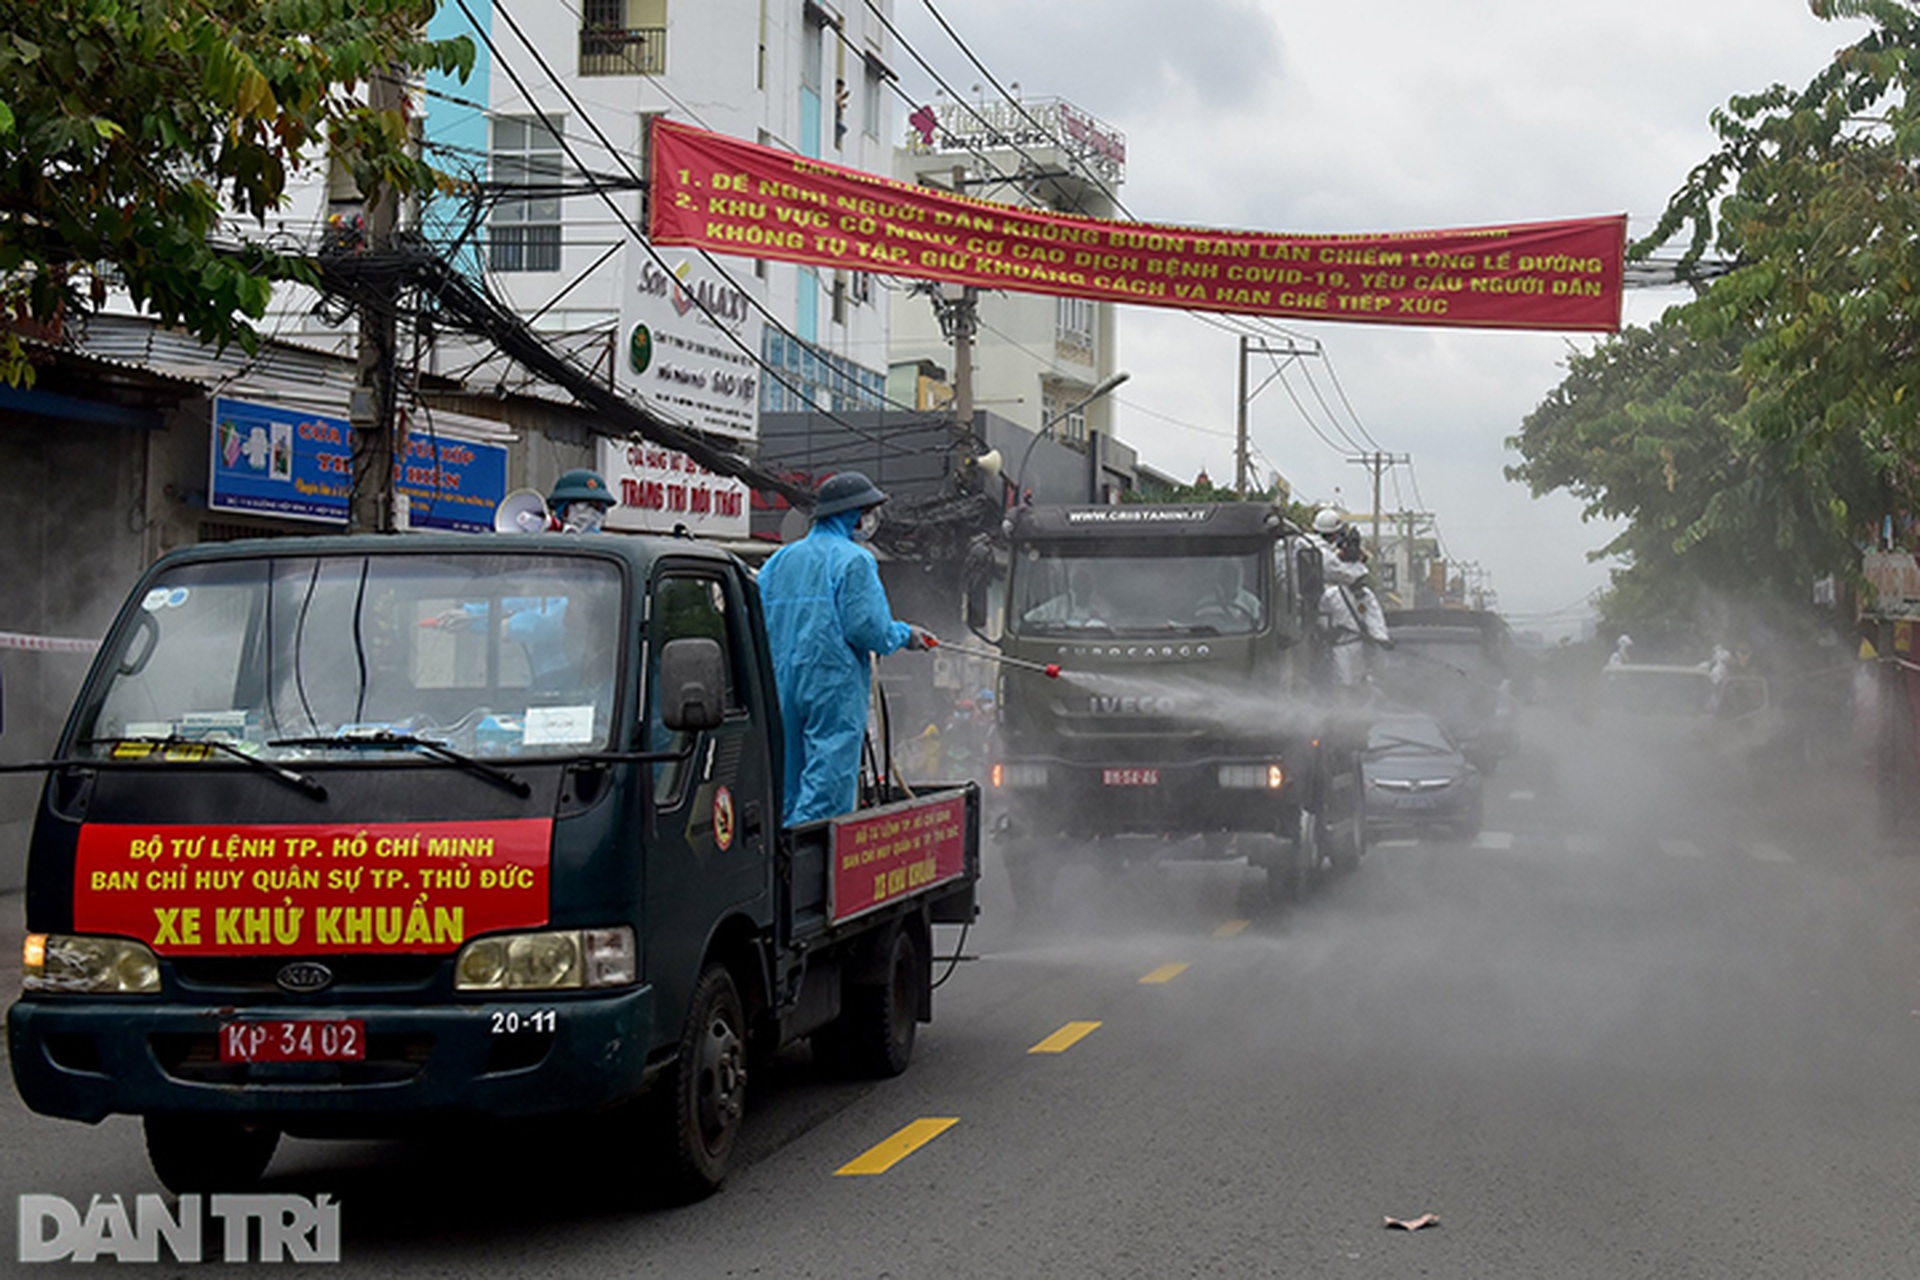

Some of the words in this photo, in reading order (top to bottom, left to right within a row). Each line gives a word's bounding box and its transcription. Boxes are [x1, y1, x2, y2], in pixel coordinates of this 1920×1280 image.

[678, 169, 701, 188] 1.
[759, 179, 829, 207] NGHỊ
[837, 195, 925, 222] NGƯỜI
[935, 209, 993, 233] DÂN
[1002, 218, 1100, 245] KHÔNG
[1411, 250, 1475, 270] LÒNG
[1518, 253, 1602, 273] ĐƯỜNG
[675, 191, 698, 211] 2.
[709, 197, 766, 220] KHU
[776, 205, 829, 229] VỰC
[840, 214, 876, 235] CÓ
[967, 237, 1004, 256] CƠ
[1012, 243, 1066, 264] CAO
[1074, 251, 1138, 272] DỊCH
[1147, 258, 1218, 280] BỆNH
[1360, 270, 1405, 290] YÊU
[1470, 274, 1545, 295] NGƯỜI
[1551, 276, 1602, 297] DÂN
[706, 221, 804, 249] KHÔNG
[813, 234, 847, 257] TỤ
[920, 249, 971, 271] GIỮ
[975, 256, 1086, 286] KHOẢNG
[1093, 273, 1165, 297] CÁCH
[1174, 281, 1206, 300] VÀ
[1400, 294, 1448, 315] XÚC
[621, 478, 664, 511] TRANG
[1089, 697, 1176, 715] IVECO
[129, 835, 162, 863] BỘ
[171, 835, 205, 859] TƯ
[210, 834, 275, 862] LỆNH
[285, 837, 323, 858] TP.
[332, 830, 368, 858] HỒ
[375, 834, 420, 858] CHÍ
[428, 836, 495, 858] MINH
[91, 871, 139, 890] BAN
[146, 864, 187, 890] CHỈ
[195, 870, 244, 890] HUY
[252, 868, 321, 893] QUÂN
[328, 868, 364, 894] SỰ
[371, 869, 410, 889] TP.
[419, 863, 472, 890] THỦ
[480, 865, 534, 890] ĐỨC
[154, 907, 201, 945] XE
[215, 896, 304, 945] KHỬ
[317, 893, 464, 945] KHUẨN
[285, 966, 324, 984] KIA
[491, 1010, 556, 1034] 20-11
